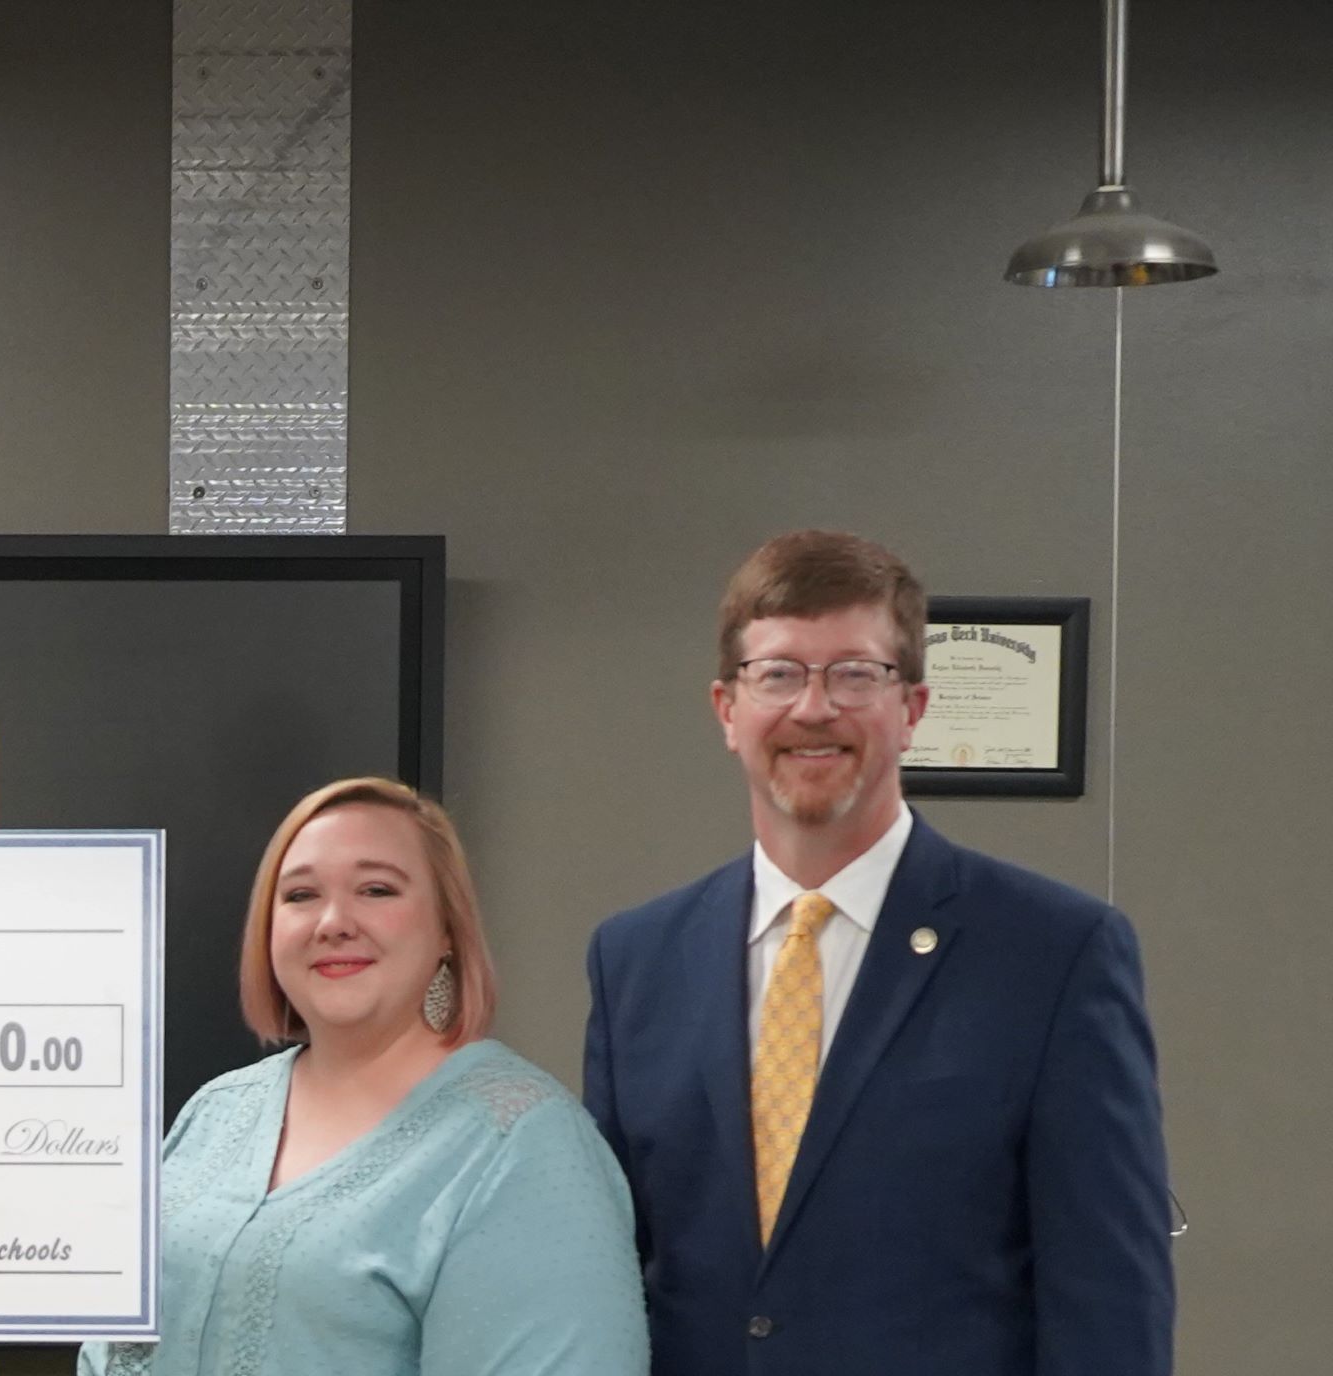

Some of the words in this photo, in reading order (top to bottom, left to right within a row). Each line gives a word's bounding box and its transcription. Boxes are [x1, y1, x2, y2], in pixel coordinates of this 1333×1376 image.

[951, 626, 978, 641] Tech
[980, 628, 1036, 664] University
[0, 1118, 121, 1157] Dollars
